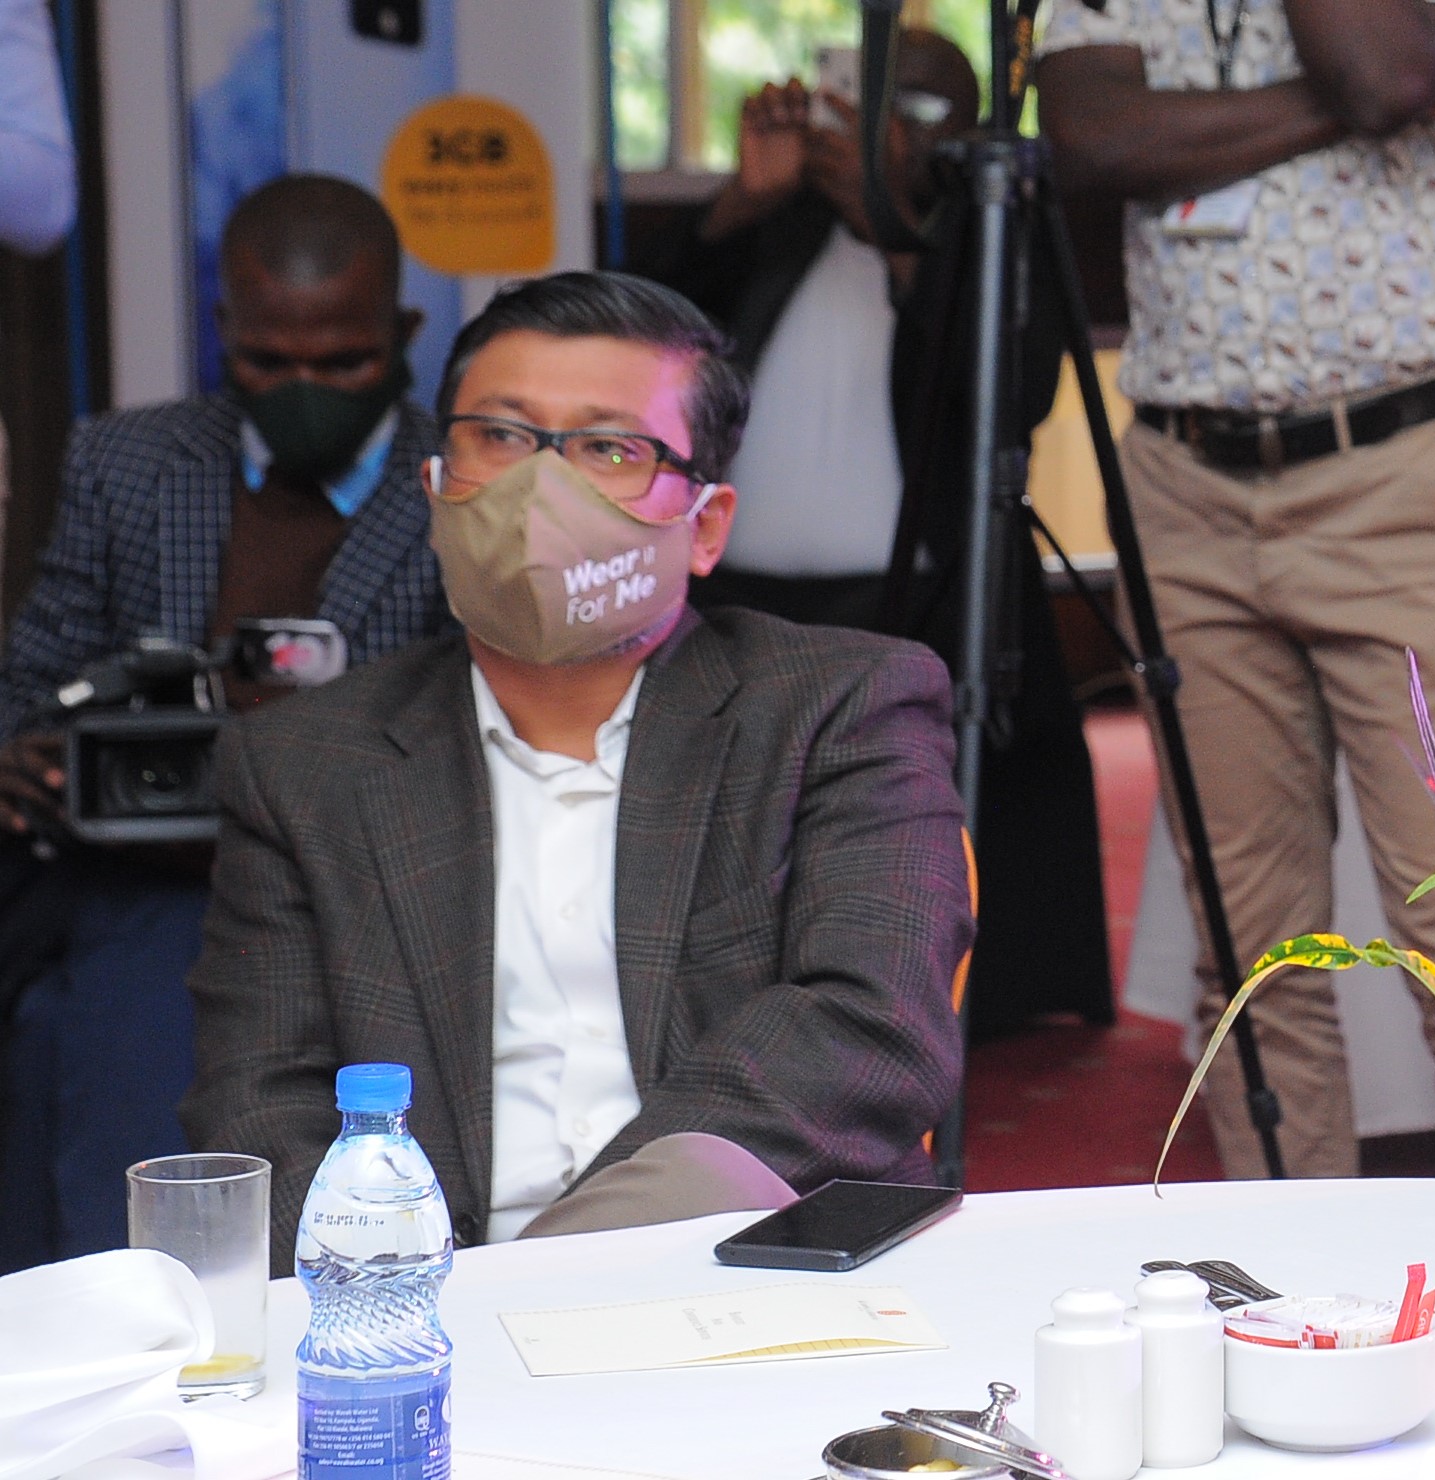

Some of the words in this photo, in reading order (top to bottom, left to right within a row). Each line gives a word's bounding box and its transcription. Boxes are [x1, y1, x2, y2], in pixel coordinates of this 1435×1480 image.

[563, 548, 640, 596] Wear
[566, 594, 607, 625] For
[615, 572, 657, 610] Me
